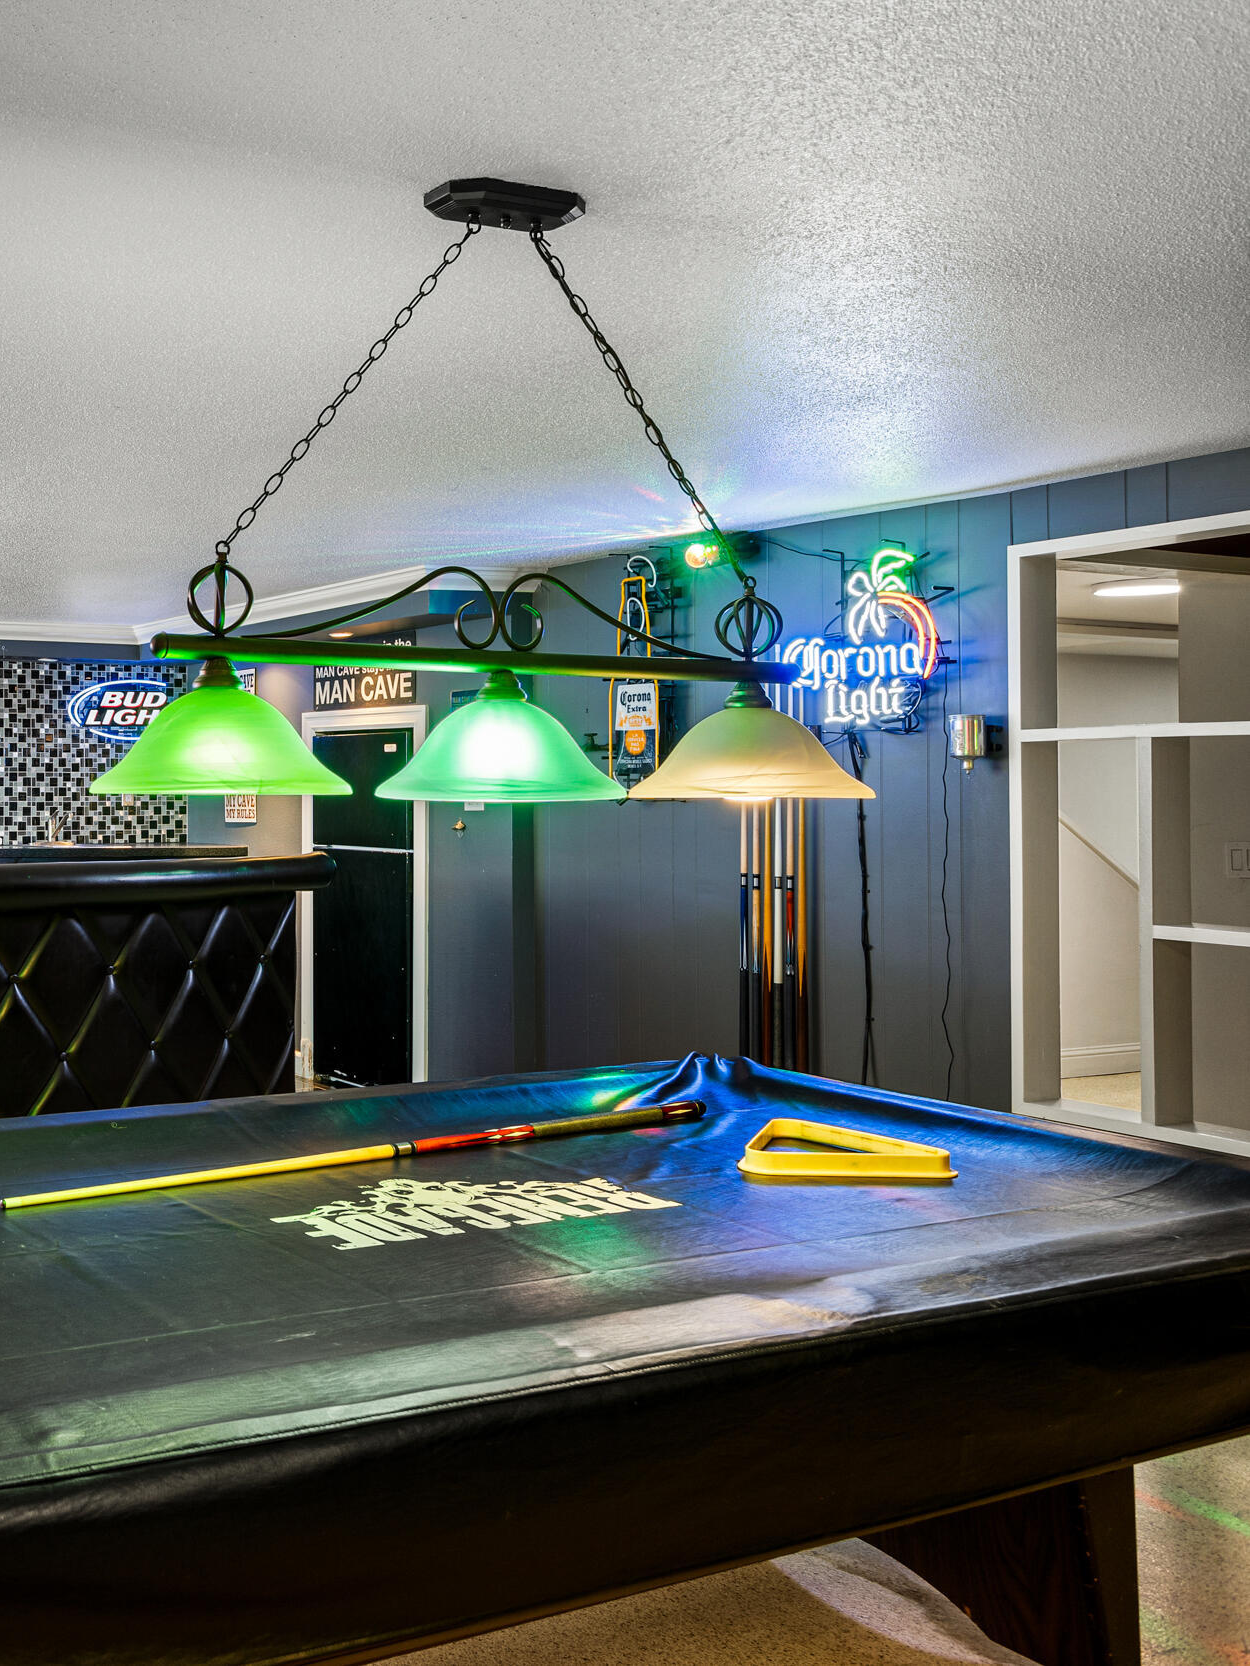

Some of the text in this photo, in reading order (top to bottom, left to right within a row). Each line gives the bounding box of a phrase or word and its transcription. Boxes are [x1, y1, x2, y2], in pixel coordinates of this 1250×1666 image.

[315, 666, 335, 679] MAN
[336, 665, 360, 677] CAVE
[782, 637, 923, 690] Corona
[315, 671, 413, 705] MAN CAVE
[100, 691, 168, 708] BUD
[620, 690, 652, 707] Corona
[824, 677, 906, 725] Light
[626, 704, 647, 713] Extra
[85, 709, 162, 726] LIGH
[226, 794, 255, 807] MY CAVE
[226, 808, 256, 819] MY RULES
[269, 1177, 683, 1251] RENEGADE
